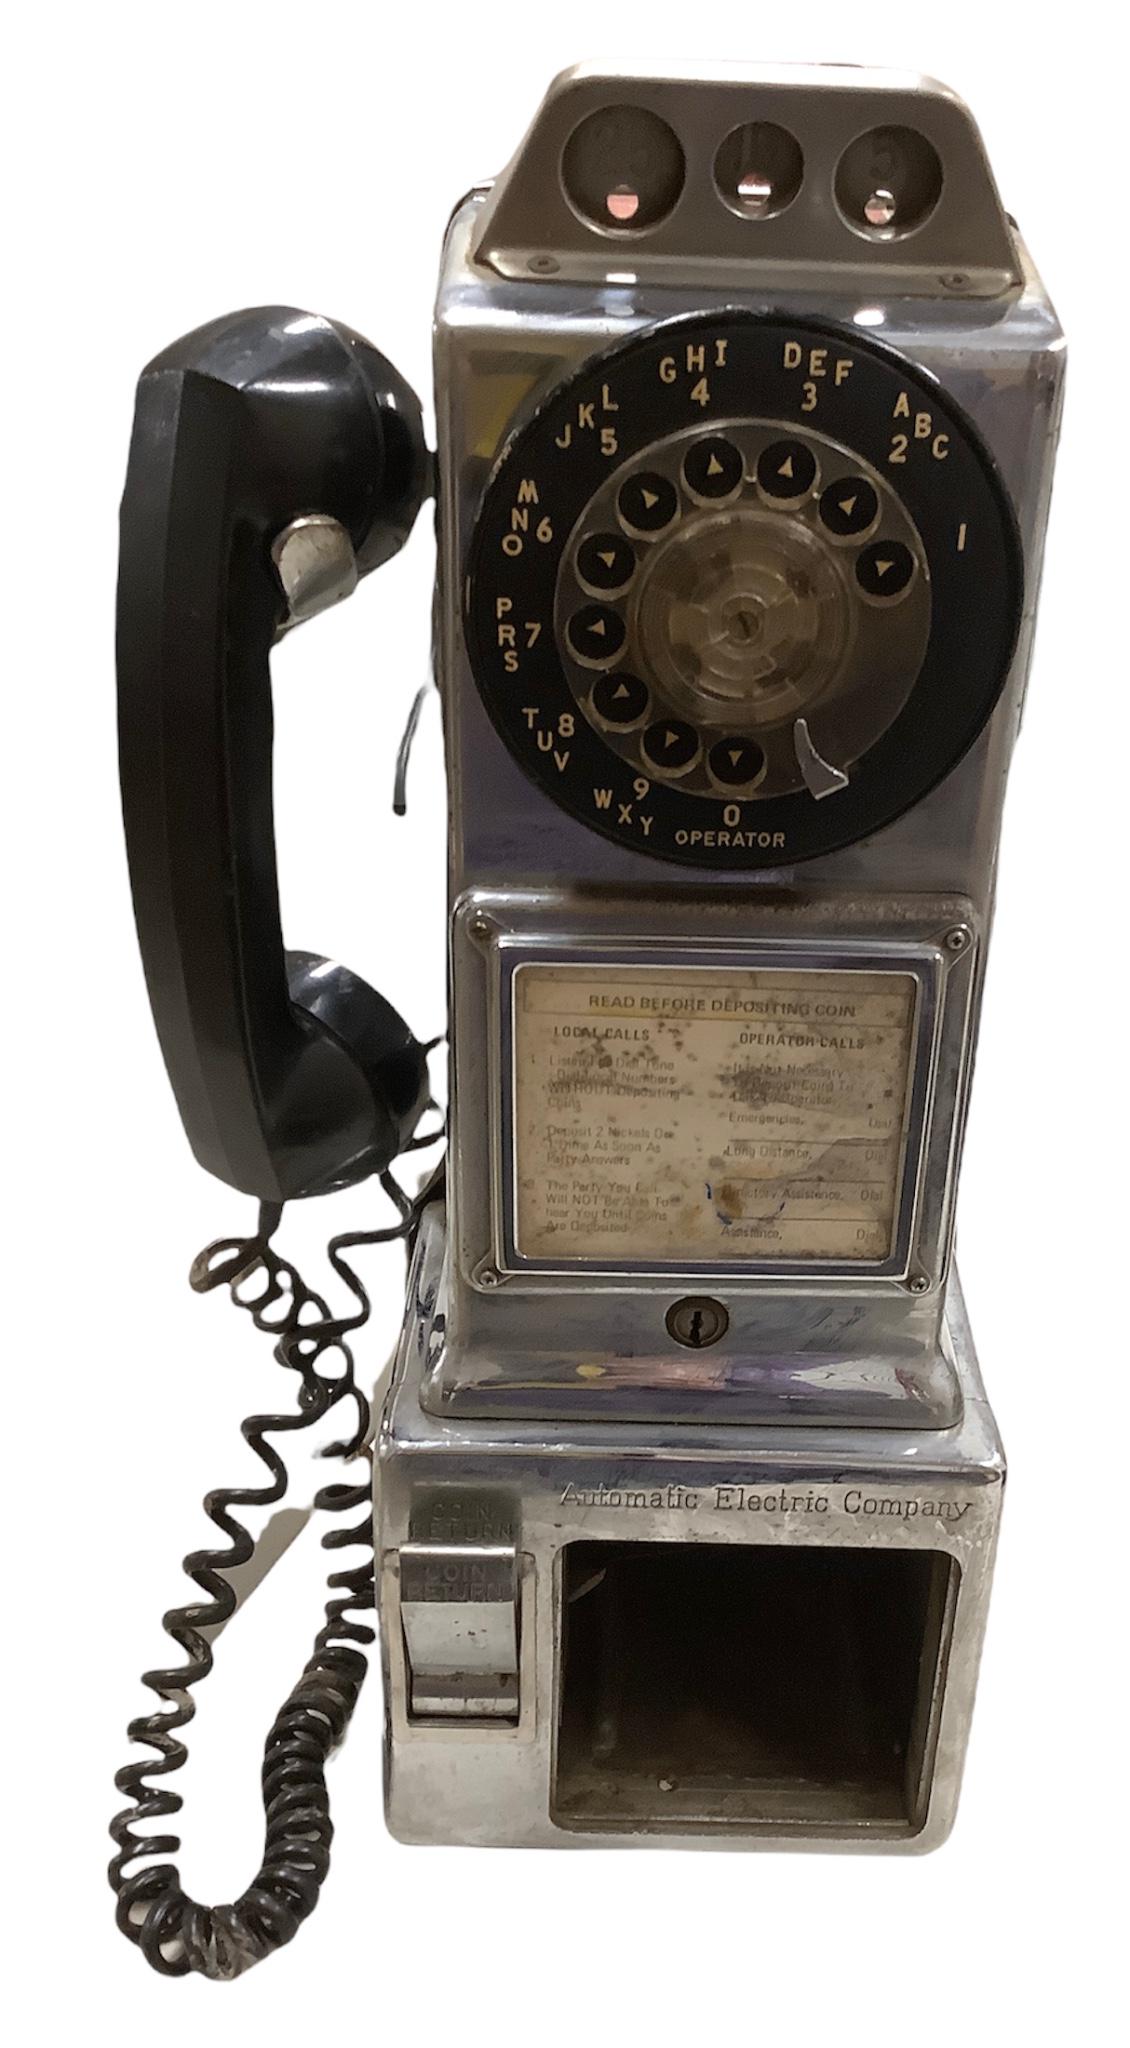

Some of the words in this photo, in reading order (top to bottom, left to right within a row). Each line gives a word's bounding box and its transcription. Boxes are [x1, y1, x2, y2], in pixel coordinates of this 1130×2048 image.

[690, 377, 710, 407] 4
[801, 382, 818, 412] 3
[600, 428, 617, 456] 5
[888, 434, 908, 463] 2
[536, 516, 553, 543] 6
[525, 622, 541, 649] 7
[558, 713, 575, 737] 8
[633, 778, 650, 801] 9
[675, 830, 786, 848] OPERATOR
[589, 995, 635, 1007] READ
[640, 997, 705, 1011] BEFORE
[711, 1000, 810, 1016] DEPOSITING
[815, 1003, 856, 1018] COIN
[554, 1025, 599, 1039] LOCAL
[605, 1027, 650, 1041] CALLS
[739, 1032, 814, 1048] OPERATOR
[820, 1034, 864, 1050] CALLS
[547, 1125, 592, 1138] Deposit
[612, 1140, 641, 1153] Soon
[646, 1142, 661, 1154] As
[546, 1180, 568, 1192] The
[572, 1180, 600, 1194] Party
[607, 1182, 631, 1194] You
[546, 1194, 567, 1205] Will
[572, 1194, 599, 1206] NOT
[576, 1208, 598, 1221] You
[602, 1209, 632, 1221] Until
[560, 1482, 698, 1511] Automatic
[713, 1487, 829, 1513] Electric
[843, 1490, 974, 1520] Company
